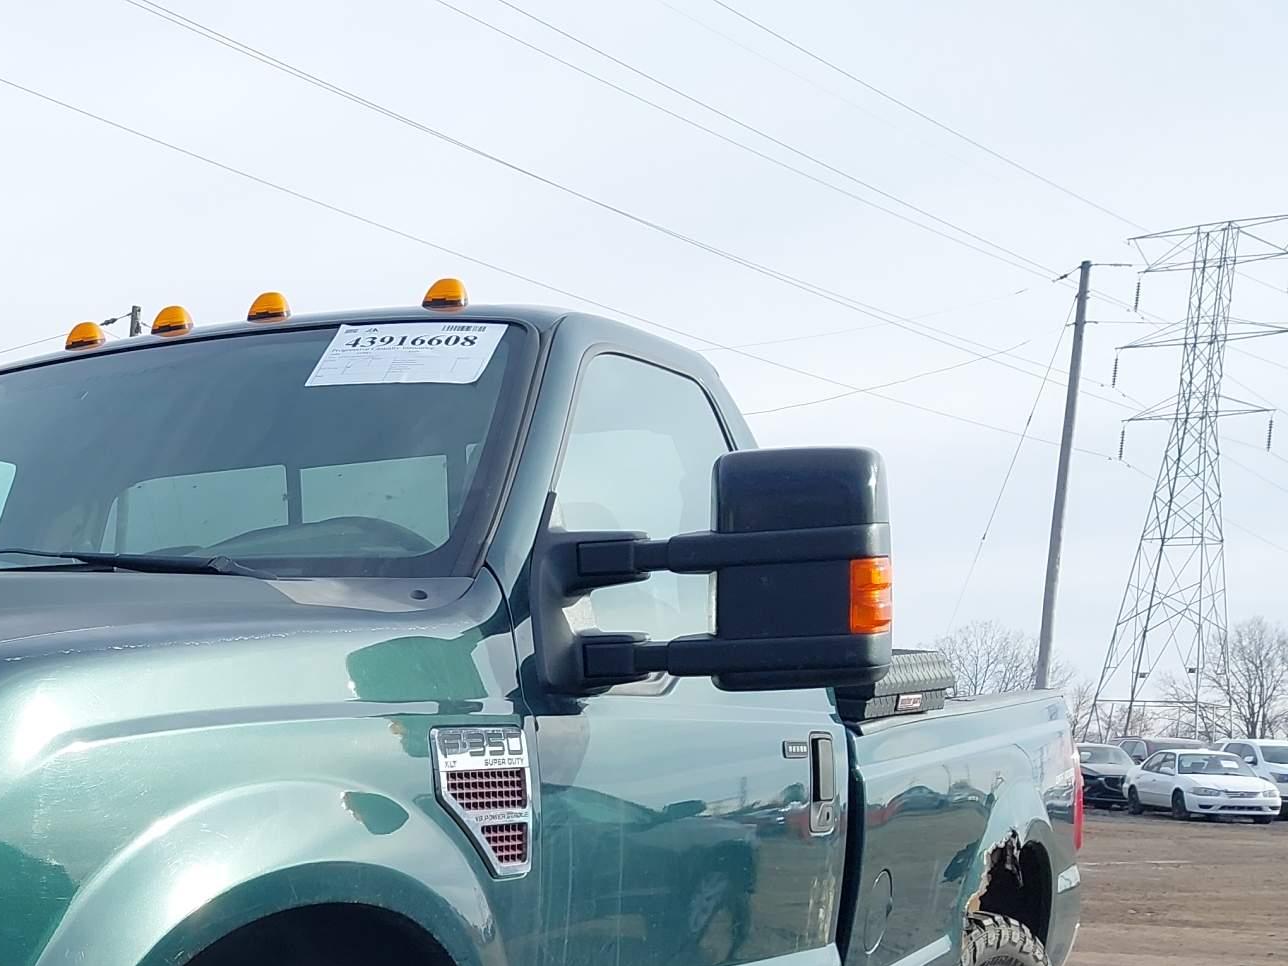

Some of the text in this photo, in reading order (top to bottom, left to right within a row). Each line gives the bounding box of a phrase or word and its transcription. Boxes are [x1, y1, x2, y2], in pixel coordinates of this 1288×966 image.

[345, 334, 479, 348] 43916608
[444, 760, 457, 768] XLT
[484, 757, 524, 767] SUPER DUTY
[484, 813, 505, 821] POWER
